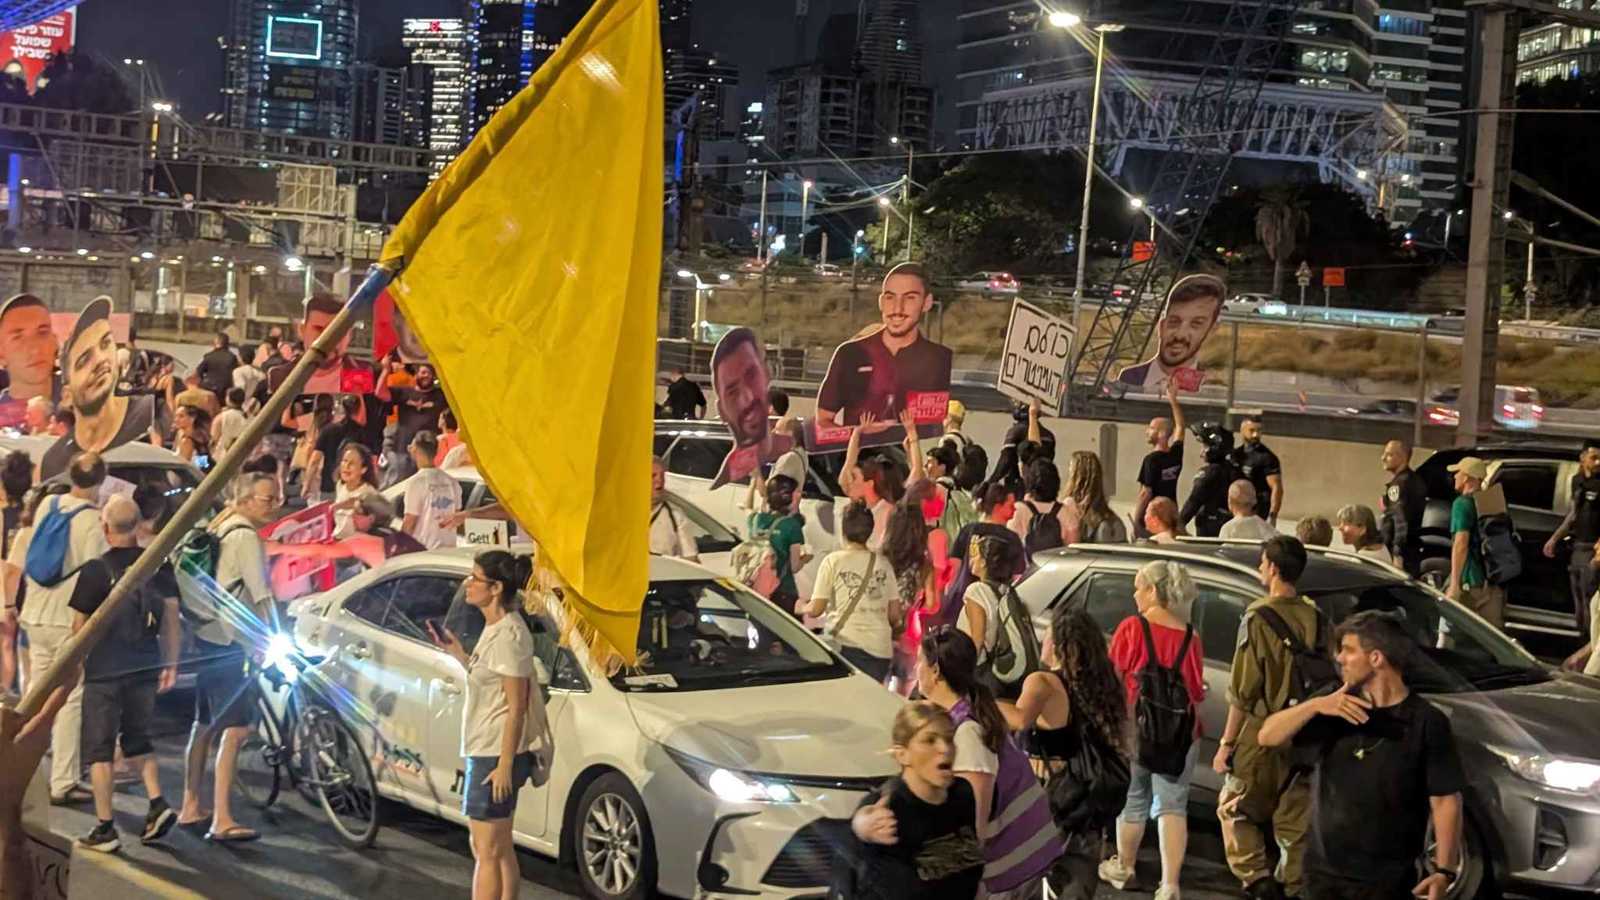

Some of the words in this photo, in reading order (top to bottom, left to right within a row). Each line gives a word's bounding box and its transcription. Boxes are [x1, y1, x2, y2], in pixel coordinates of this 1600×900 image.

[14, 34, 52, 47] שפועל
[1024, 322, 1069, 359] כולם
[468, 531, 490, 545] Gett
